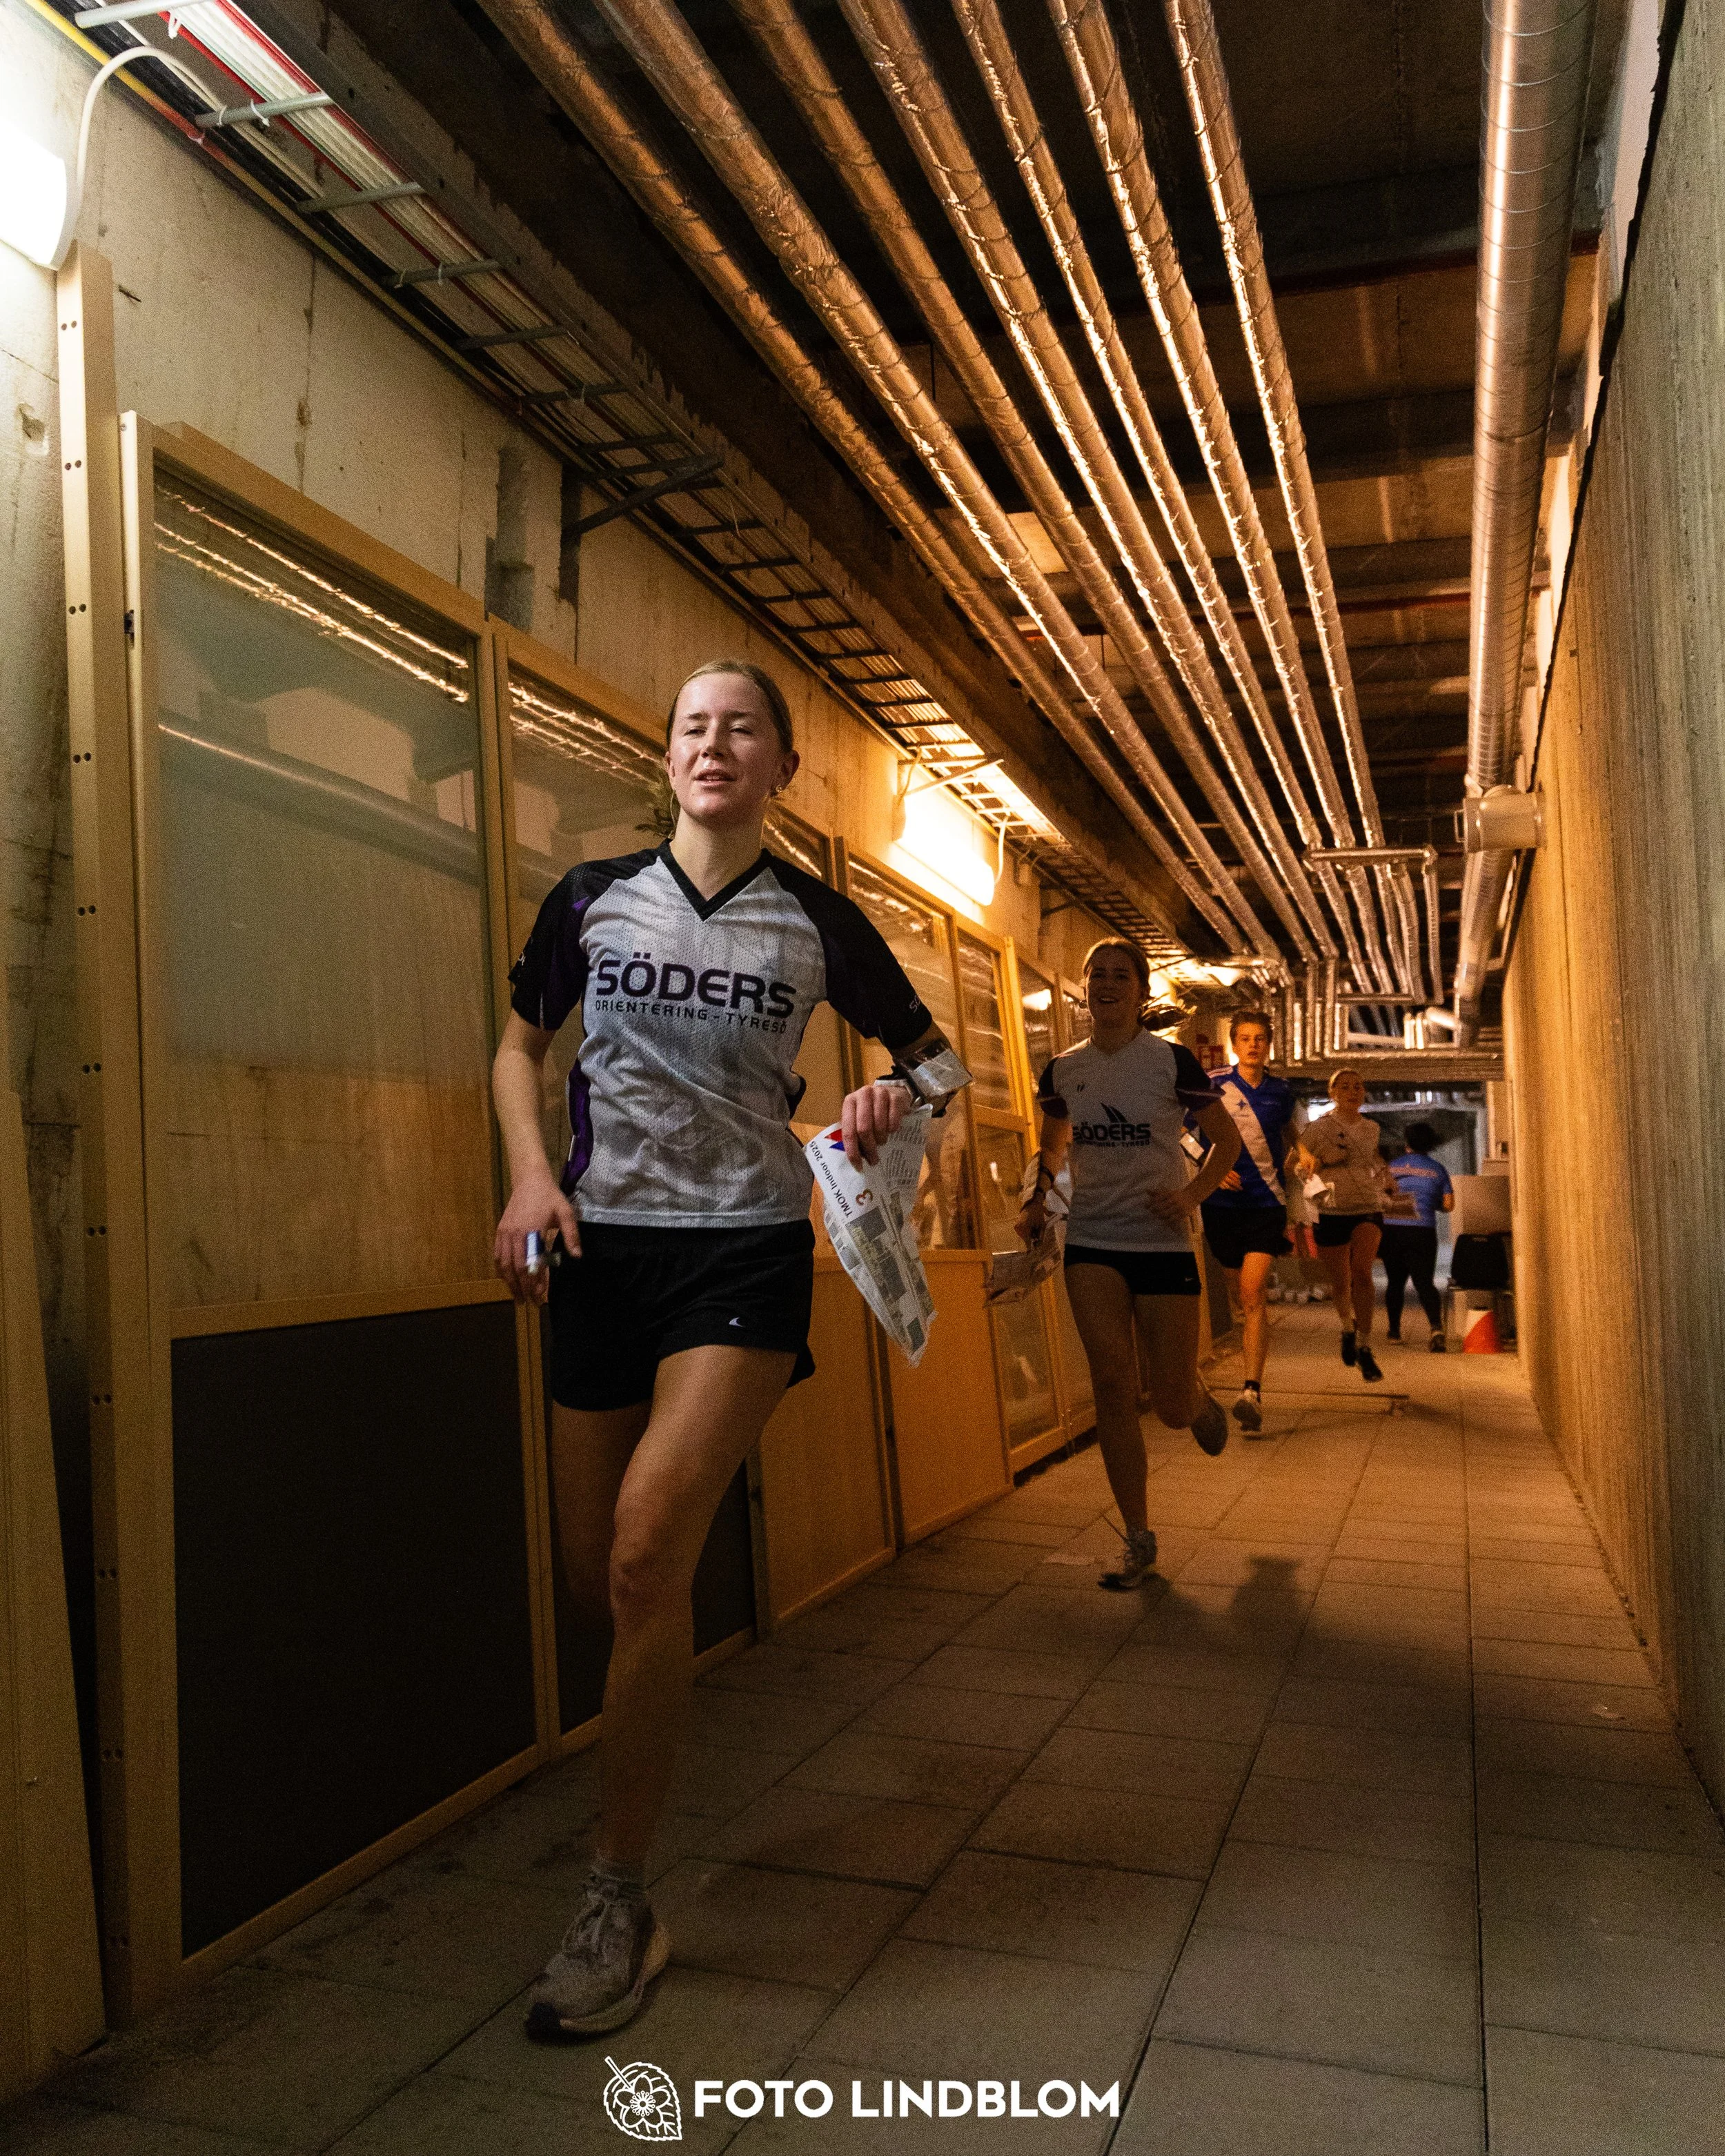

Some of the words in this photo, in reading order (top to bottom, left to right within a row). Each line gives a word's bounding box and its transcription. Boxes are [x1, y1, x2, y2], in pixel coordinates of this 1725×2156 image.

[596, 951, 796, 1018] SÖDERS
[595, 1000, 708, 1021] ORIENTERING
[1072, 1121, 1151, 1142] SÖDERS
[820, 1161, 838, 1190] Indoor
[834, 1189, 853, 1218] TMOK
[856, 1188, 874, 1206] 3
